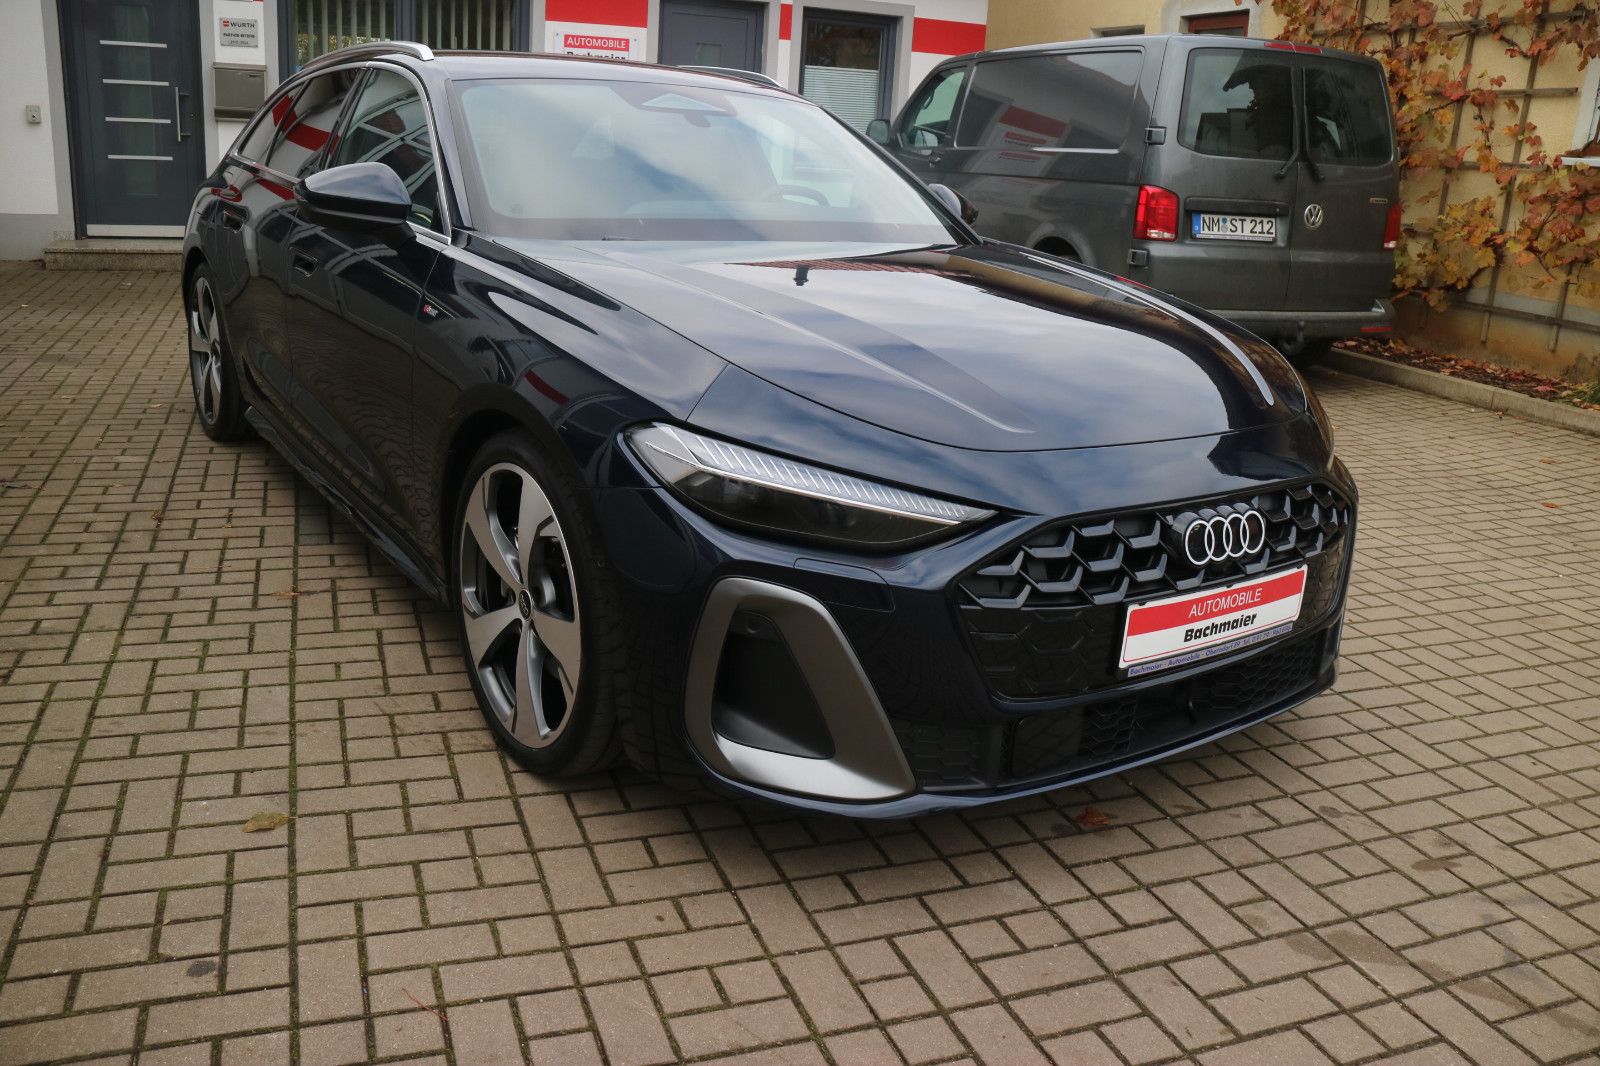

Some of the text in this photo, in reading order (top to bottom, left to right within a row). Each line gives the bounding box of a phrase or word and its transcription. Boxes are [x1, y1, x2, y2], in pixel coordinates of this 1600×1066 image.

[566, 37, 626, 48] AUTOMOBILE
[1202, 216, 1220, 232] NM
[1229, 217, 1247, 233] ST
[1249, 219, 1274, 235] 212
[1188, 588, 1263, 618] AUTOMOBILE
[1183, 613, 1257, 642] Bachmaier
